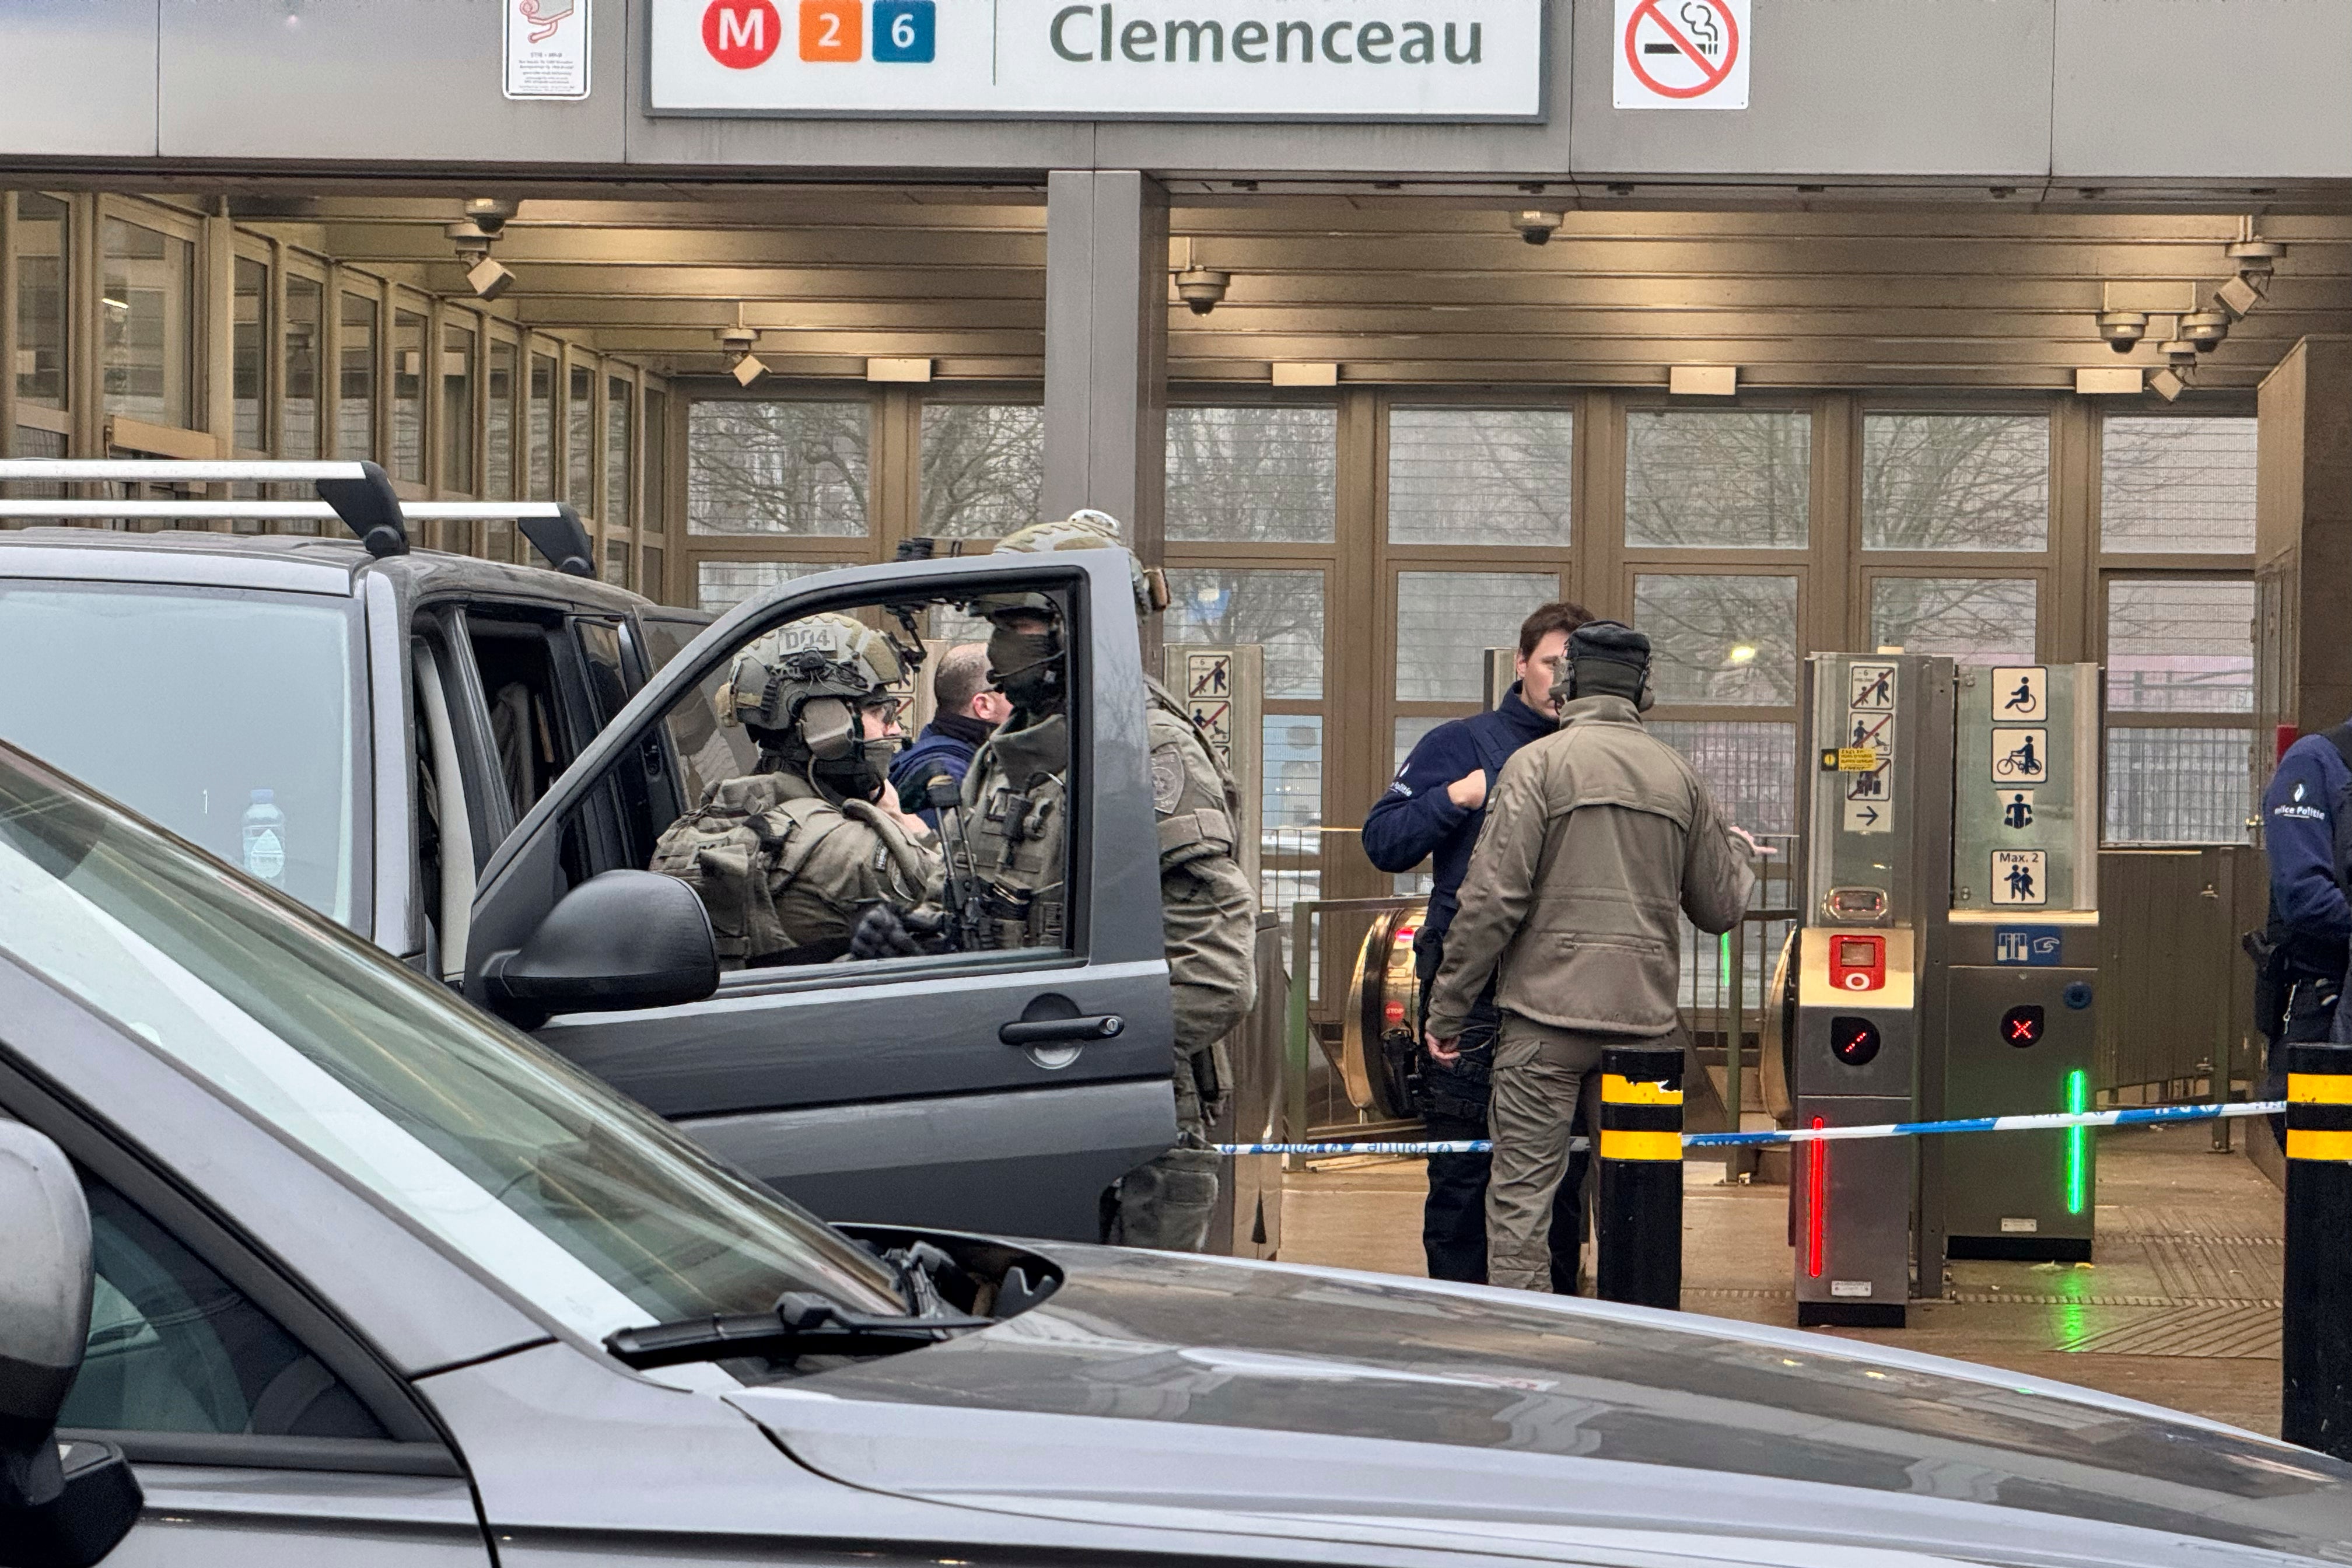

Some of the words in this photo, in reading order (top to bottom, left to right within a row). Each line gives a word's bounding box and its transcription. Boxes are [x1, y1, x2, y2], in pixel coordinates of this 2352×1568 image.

[719, 8, 764, 51] M
[818, 13, 841, 47] 2
[891, 13, 915, 48] 6
[1050, 3, 1482, 65] Clemenceau
[2297, 806, 2325, 820] Politie
[2000, 852, 2028, 863] Max.
[2032, 852, 2039, 863] 2
